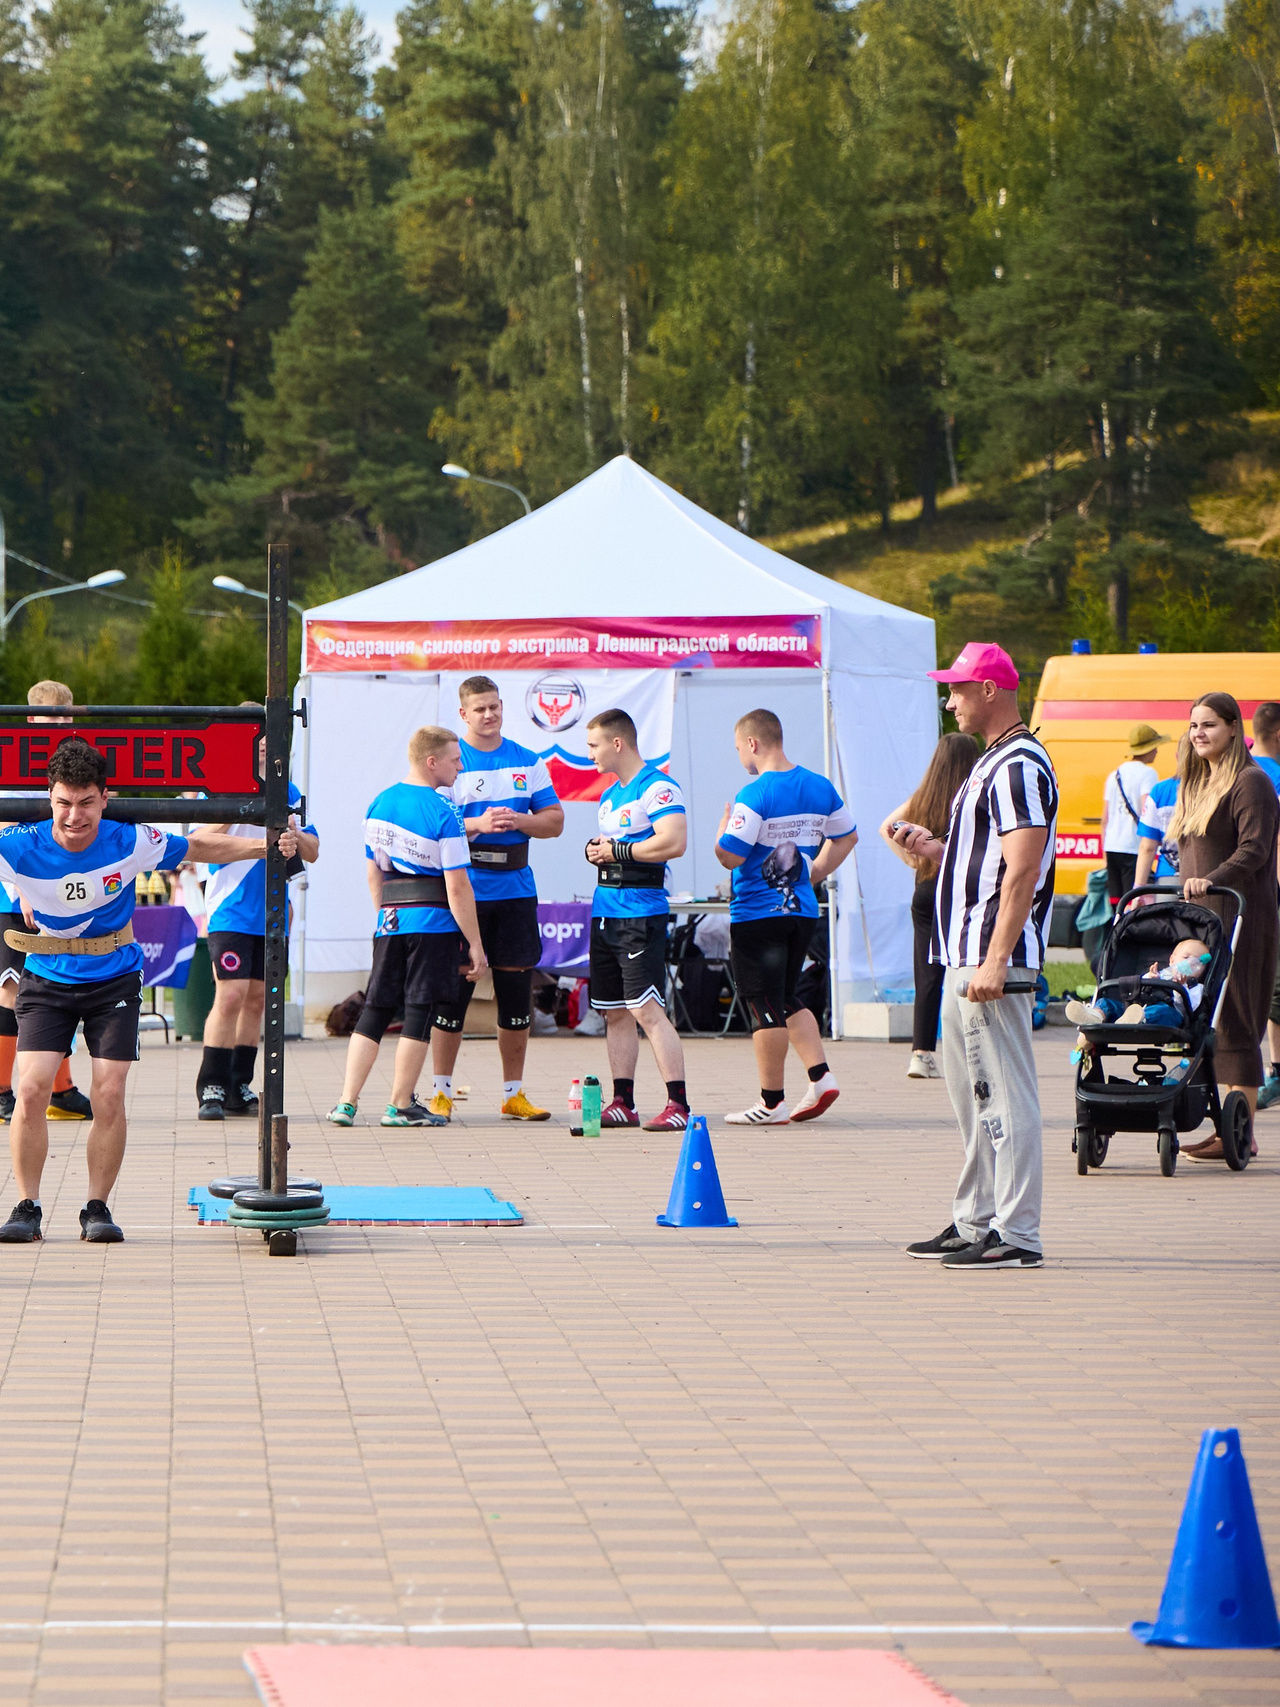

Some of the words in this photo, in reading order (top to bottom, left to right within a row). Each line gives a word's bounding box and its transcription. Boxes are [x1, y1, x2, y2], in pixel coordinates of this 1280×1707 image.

[319, 637, 414, 659] Федерация
[422, 638, 501, 654] силового
[507, 636, 589, 657] экстрима
[595, 633, 730, 656] Ленинградской
[736, 634, 808, 652] области
[475, 778, 485, 793] 2
[65, 882, 87, 901] 25
